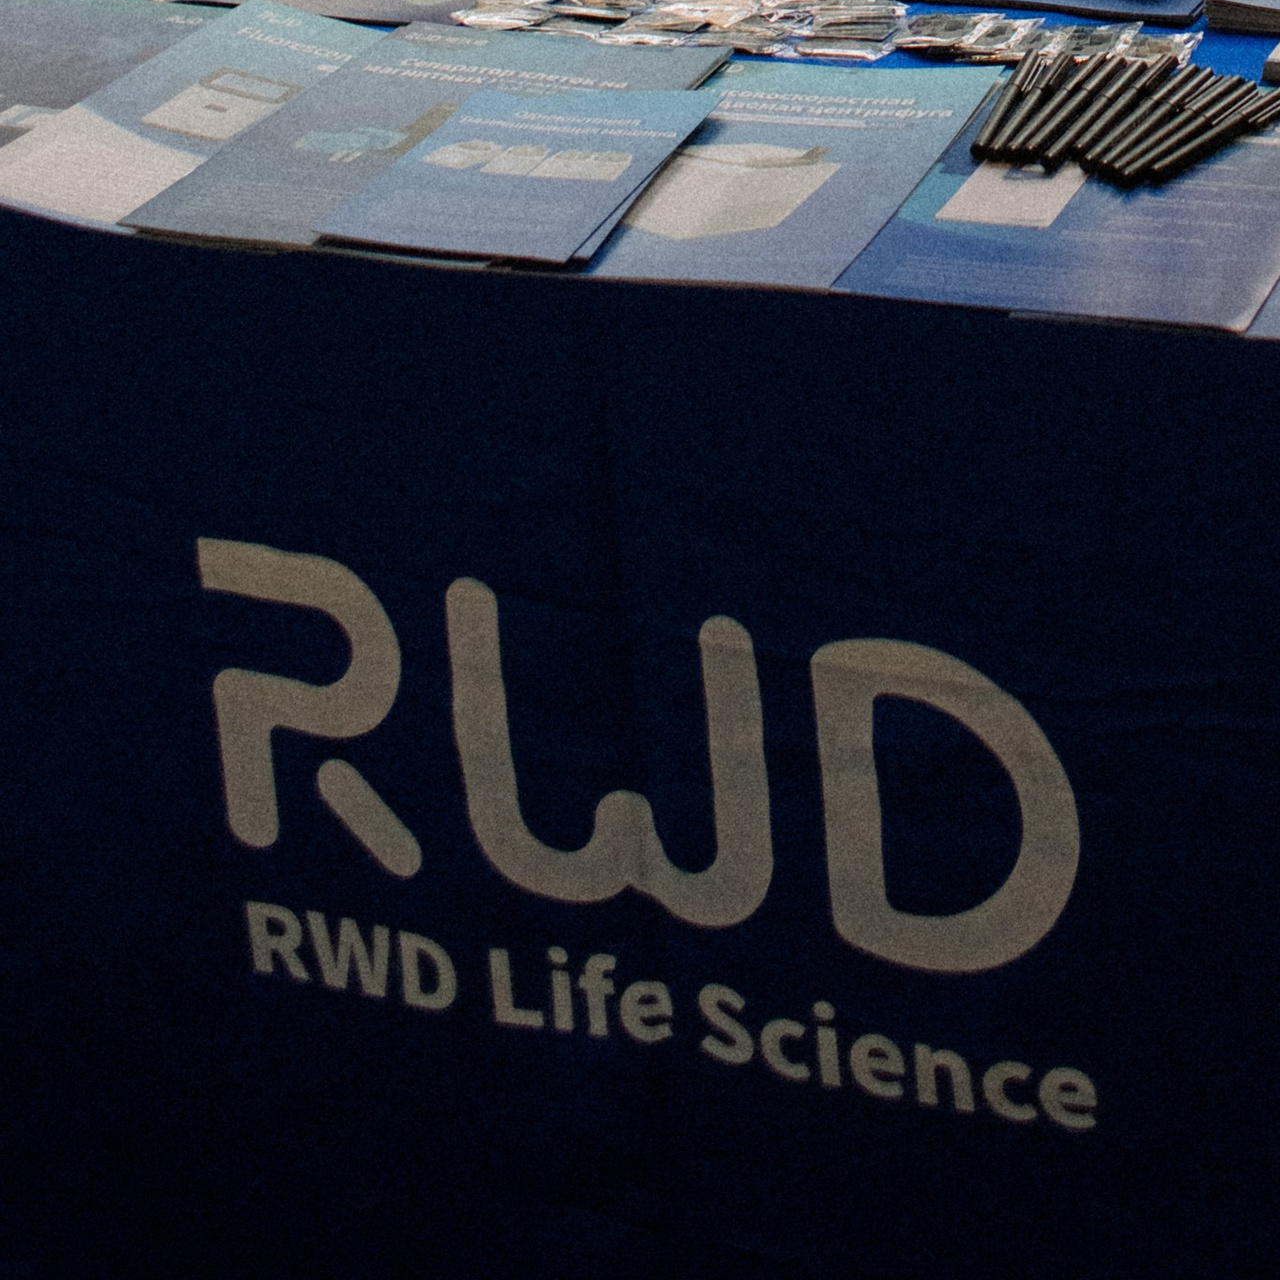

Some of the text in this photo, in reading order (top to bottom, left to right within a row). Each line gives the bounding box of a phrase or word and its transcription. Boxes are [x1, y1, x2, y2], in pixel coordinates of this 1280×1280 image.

[807, 104, 955, 120] центрифуга
[196, 536, 1081, 974] RWD
[244, 899, 1099, 1133] RWD Life Science
